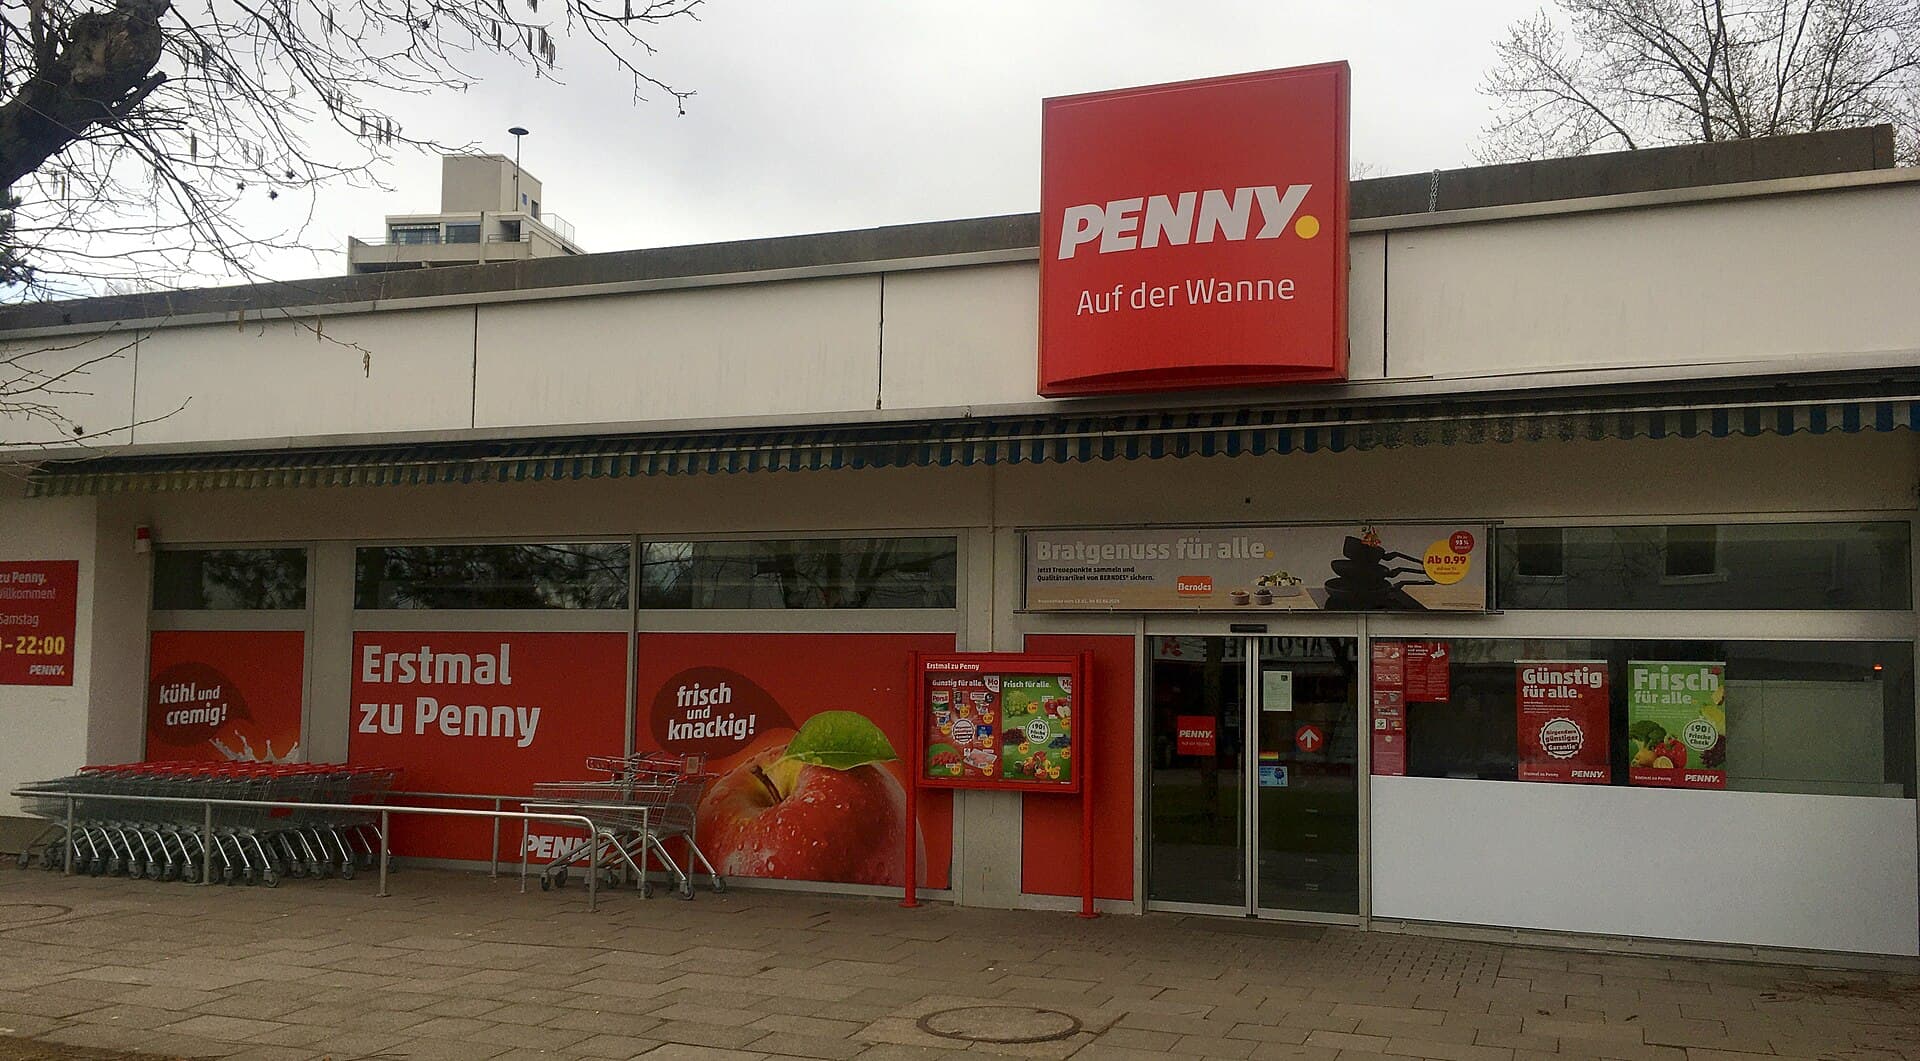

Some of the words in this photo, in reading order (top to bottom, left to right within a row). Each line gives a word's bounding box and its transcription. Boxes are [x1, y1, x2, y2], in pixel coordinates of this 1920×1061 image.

[1058, 184, 1319, 260] PENNY.
[1077, 283, 1123, 315] Auf
[1130, 281, 1178, 309] der
[1186, 277, 1294, 304] Wanne
[1037, 540, 1169, 564] Bratgenuss
[1176, 537, 1211, 560] für
[1217, 536, 1274, 560] alle.
[1427, 555, 1442, 565] Ab
[1444, 555, 1467, 565] 0.99
[1053, 566, 1092, 575] Treuepunkte
[1093, 566, 1121, 574] sammeln
[1122, 566, 1135, 574] und
[1177, 582, 1212, 592] Berndes
[16, 635, 66, 656] 22:00
[29, 664, 66, 677] PENNY.
[362, 642, 512, 686] Erstmal
[926, 662, 951, 671] Erstmal
[959, 662, 980, 673] Penny
[932, 679, 957, 689] Günstig
[958, 679, 969, 688] für
[1003, 680, 1025, 689] Frisch
[1025, 680, 1036, 688] für
[1522, 666, 1603, 689] Günstig
[1634, 665, 1719, 692] Frisch
[159, 682, 196, 704] kühl
[198, 685, 221, 701] und
[677, 682, 732, 707] frisch
[1522, 685, 1546, 699] für
[1547, 686, 1583, 700] alle.
[1635, 690, 1659, 705] für
[1661, 691, 1698, 705] alle.
[166, 702, 228, 727] cremig!
[687, 705, 711, 720] und
[358, 703, 404, 735] zu
[415, 696, 542, 748] Penny
[668, 713, 756, 741] knackig!
[1695, 724, 1707, 733] 90
[1545, 734, 1578, 743] günstiger
[1688, 733, 1712, 742] Frische
[1570, 769, 1605, 779] PENNY.
[1684, 773, 1720, 784] PENNY.
